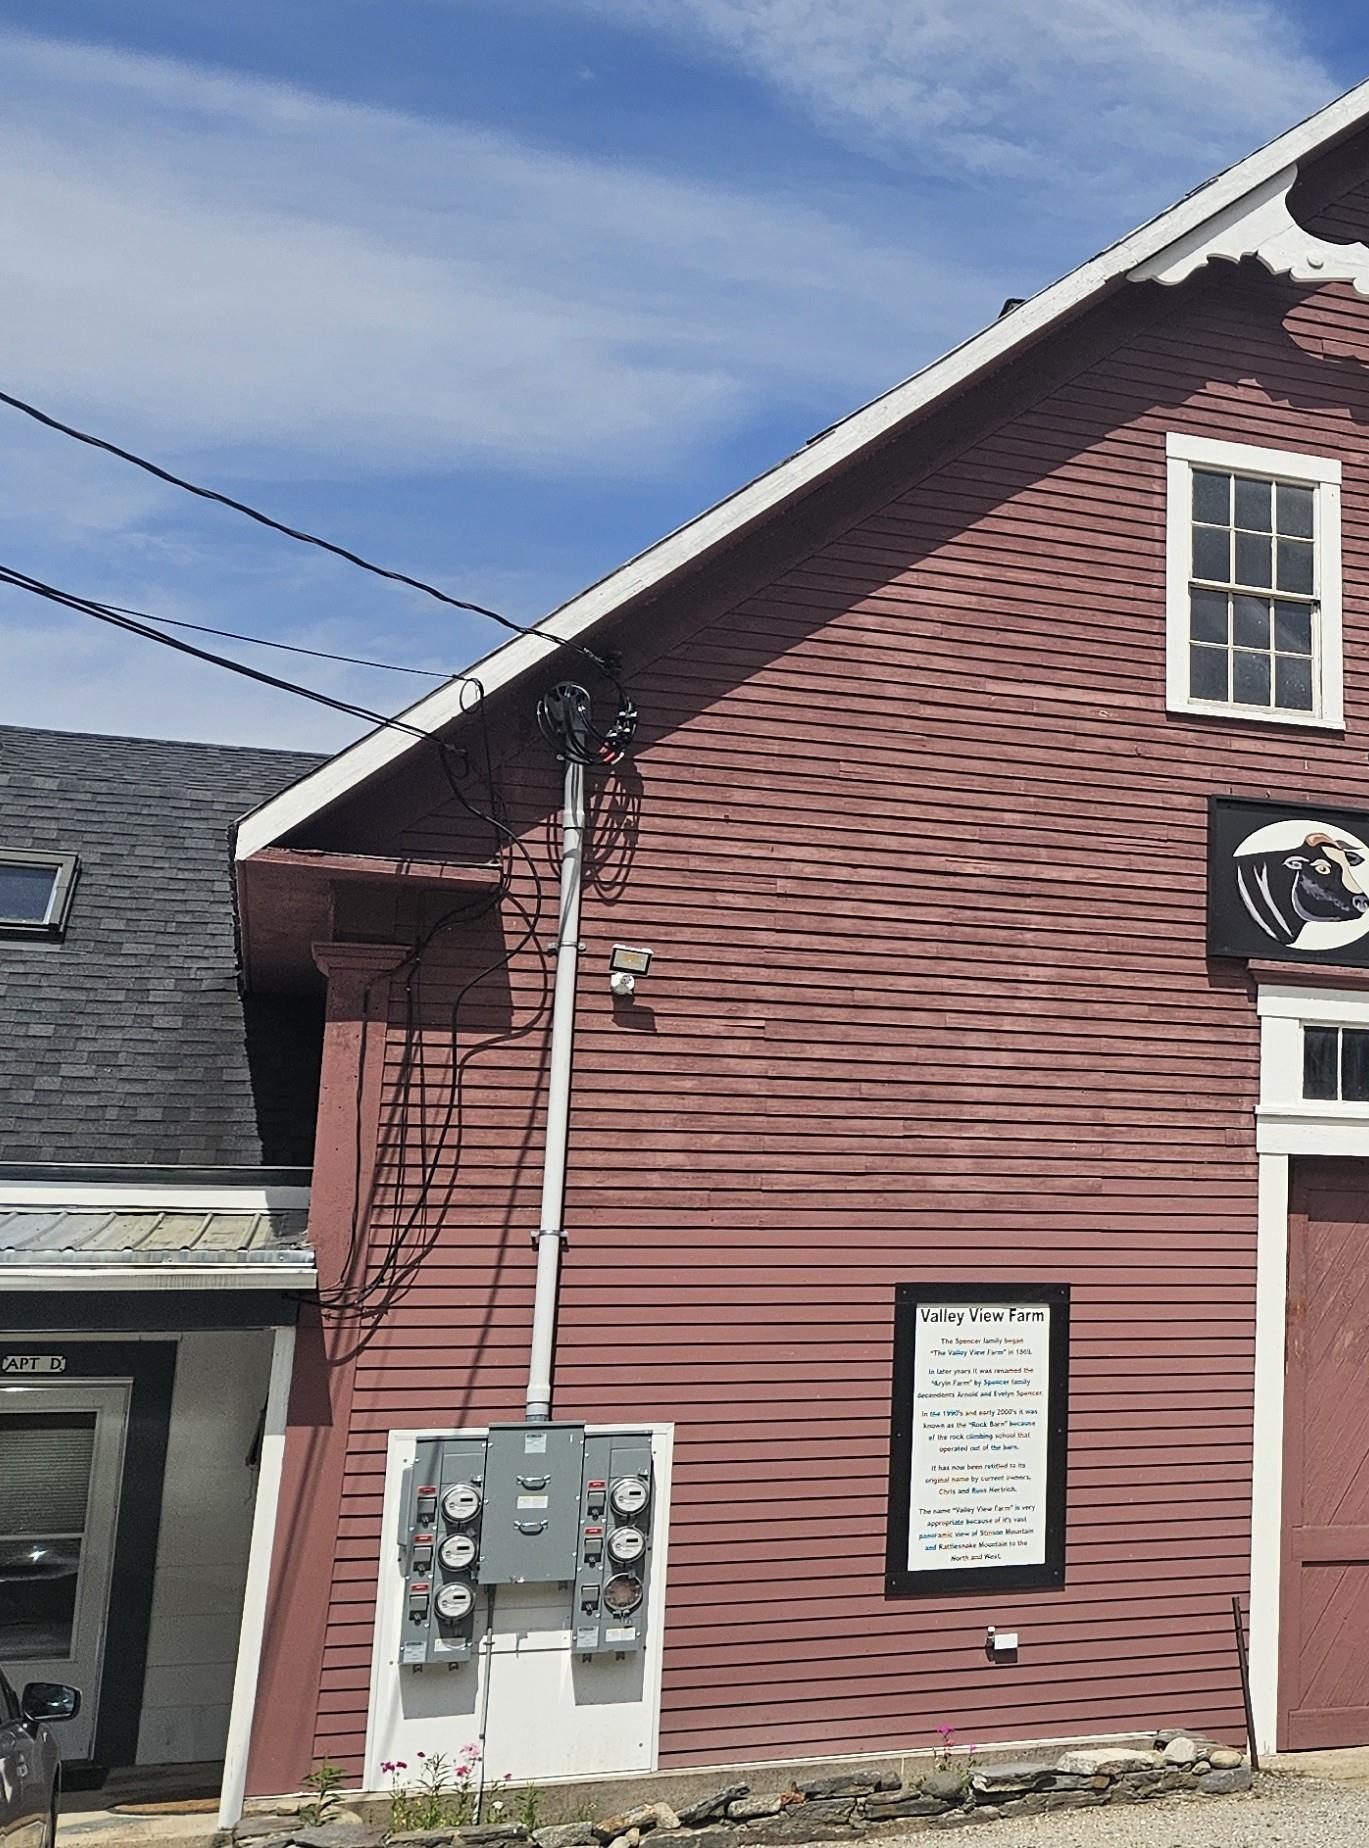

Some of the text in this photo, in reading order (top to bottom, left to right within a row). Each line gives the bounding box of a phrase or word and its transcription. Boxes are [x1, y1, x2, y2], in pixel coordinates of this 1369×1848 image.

[921, 1308, 1044, 1326] Valley View Farm
[955, 1338, 981, 1346] Spencer
[6, 1358, 61, 1370] APT D
[966, 1433, 993, 1441] climbing
[925, 1477, 950, 1485] original
[918, 1532, 952, 1541] panoramic
[939, 1542, 976, 1550] Rattlesnake
